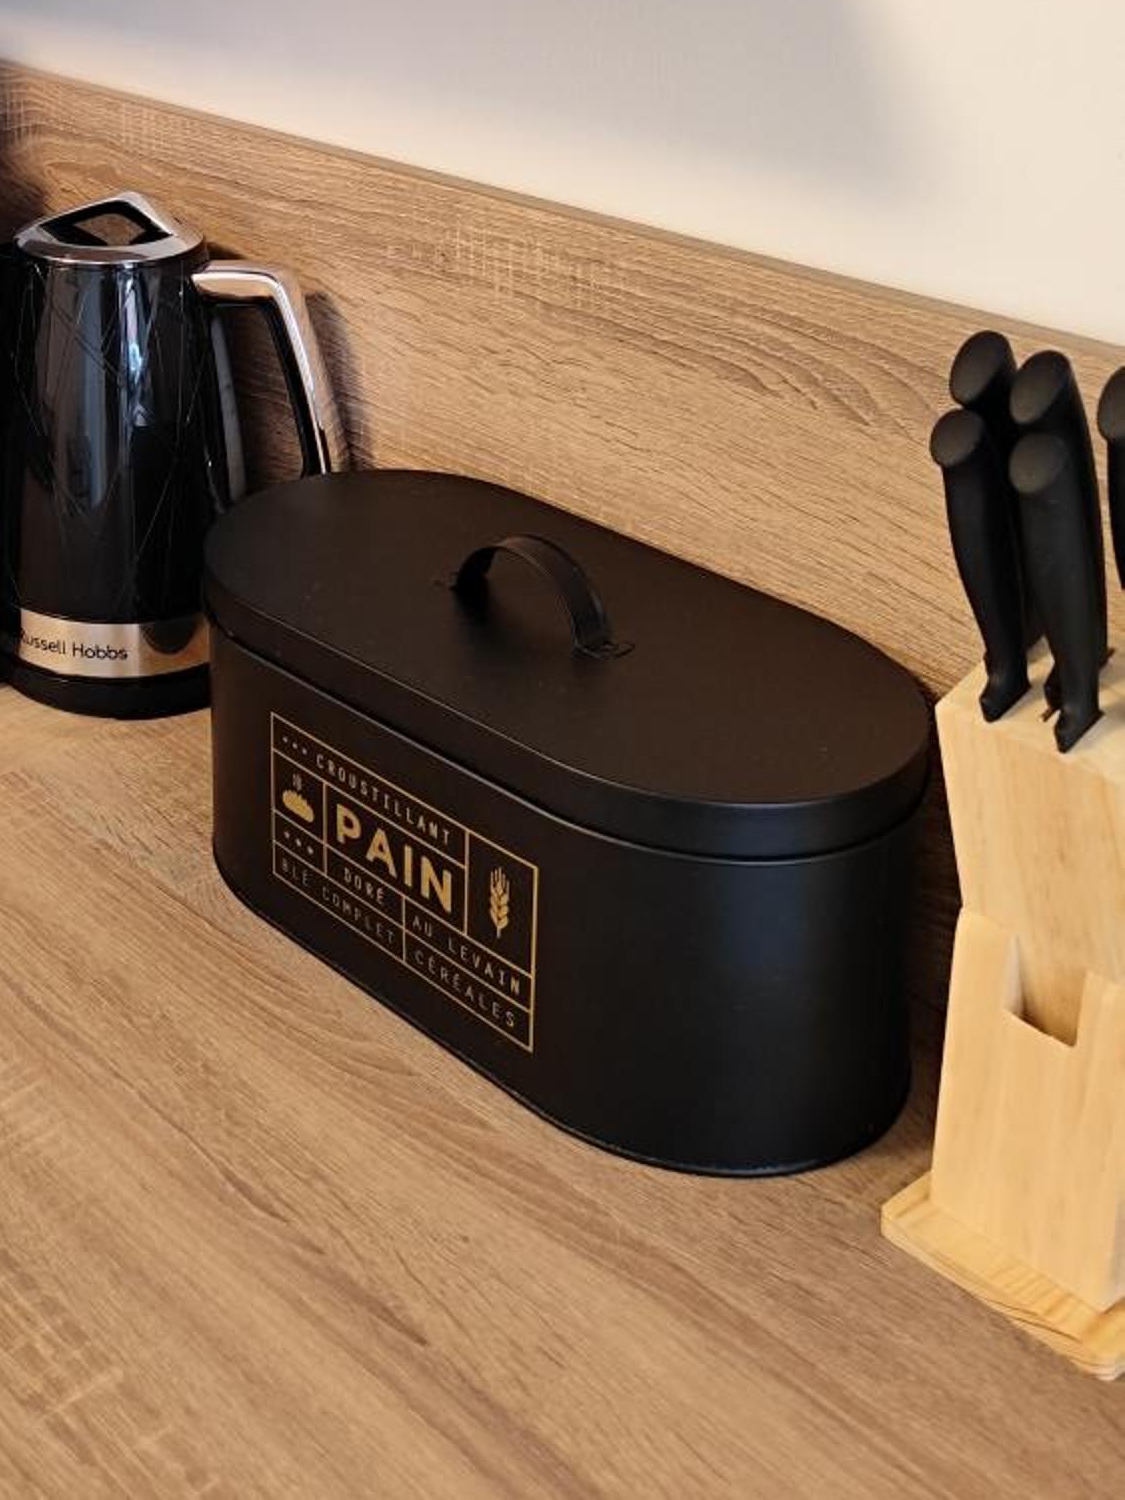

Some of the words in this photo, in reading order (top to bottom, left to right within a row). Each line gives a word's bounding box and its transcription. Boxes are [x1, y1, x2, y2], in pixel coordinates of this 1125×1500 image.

[72, 643, 129, 661] Hobbs
[315, 752, 452, 846] CROUSTILLANT
[335, 802, 453, 915] PAIN
[343, 866, 386, 903] DORÉ
[280, 857, 309, 887] BLÉ
[321, 885, 396, 946] COMPLET
[412, 915, 433, 937] AU
[447, 934, 522, 997] LEVAIN
[413, 948, 516, 1029] CÉRÉALES
